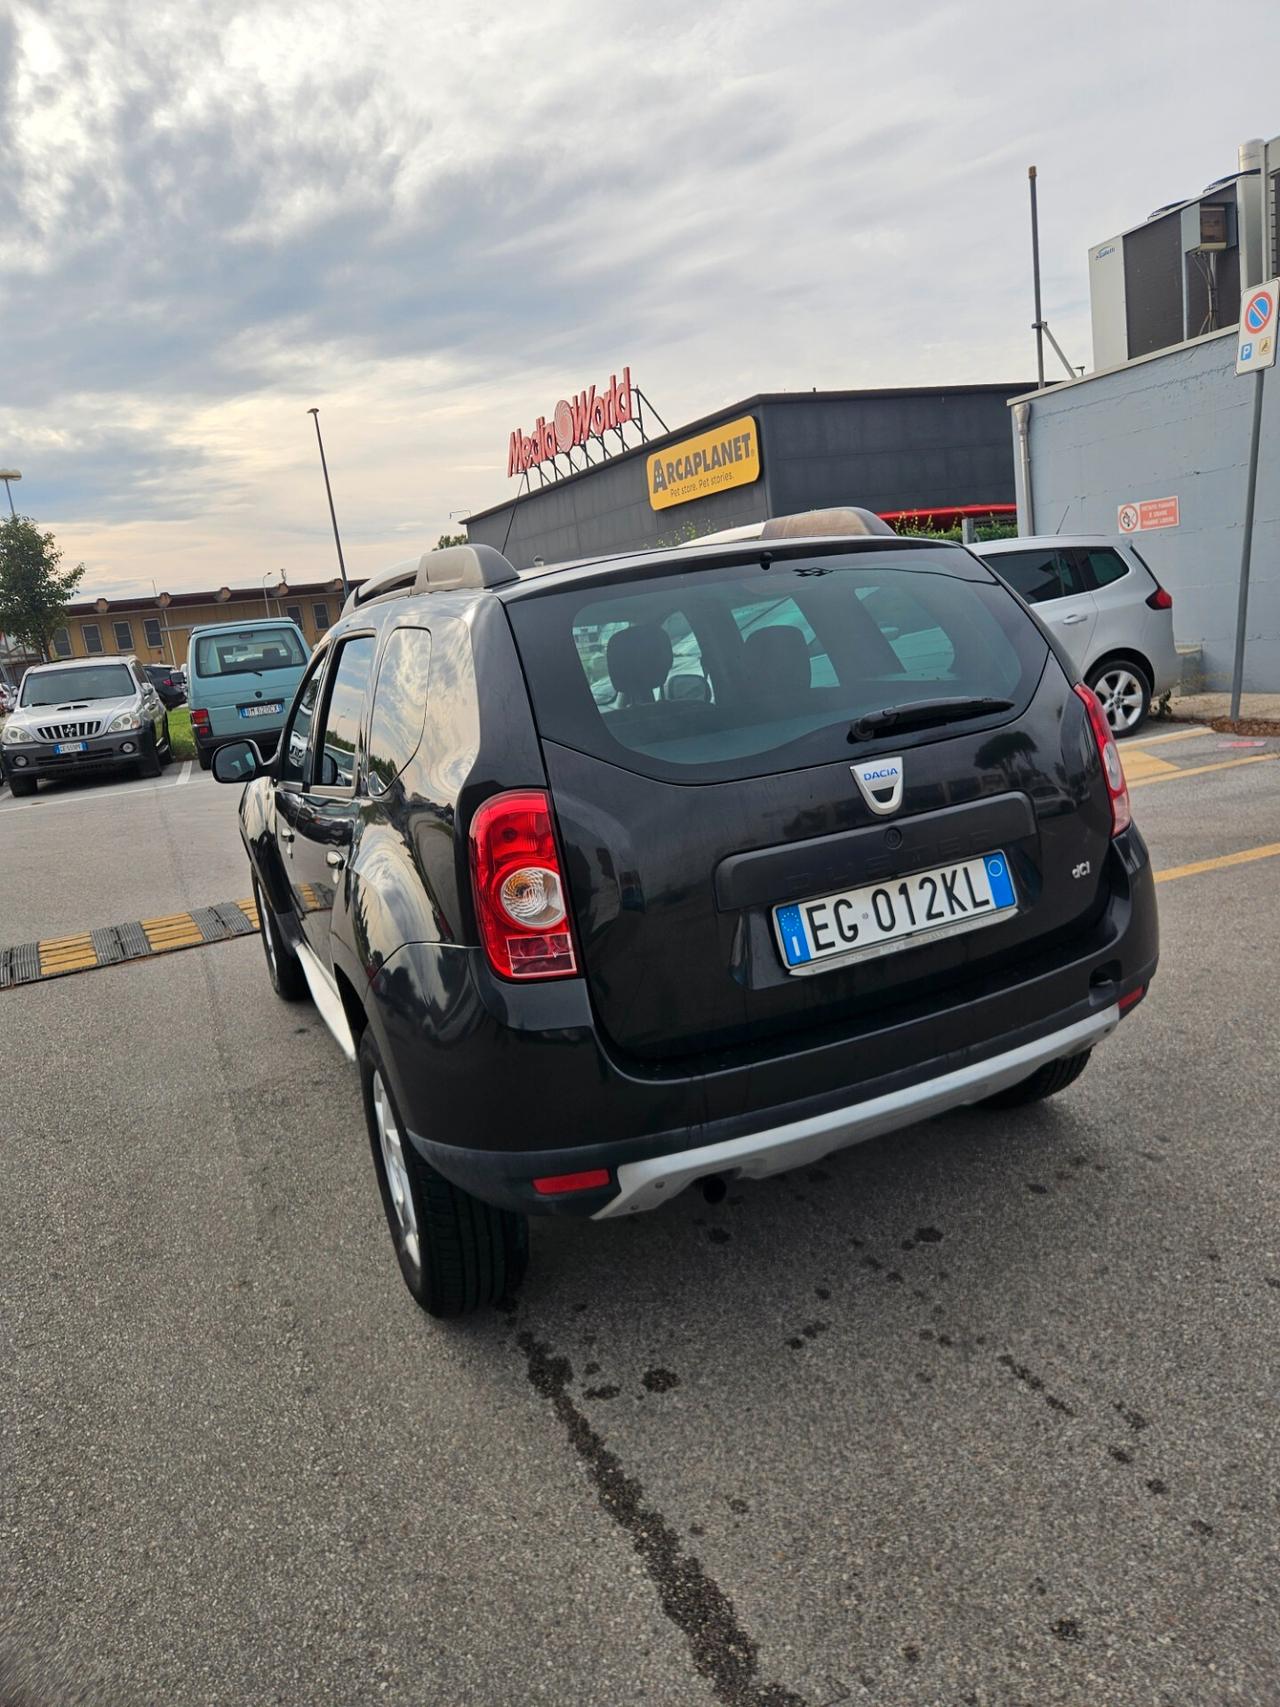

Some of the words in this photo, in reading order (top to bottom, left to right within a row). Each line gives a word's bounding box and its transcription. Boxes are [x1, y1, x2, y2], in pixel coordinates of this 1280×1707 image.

[508, 416, 557, 478] Media
[571, 366, 632, 446] World
[653, 431, 751, 494] ARCAPLANET
[670, 487, 681, 498] Pet
[698, 477, 710, 488] Pet
[863, 768, 898, 781] DACIA
